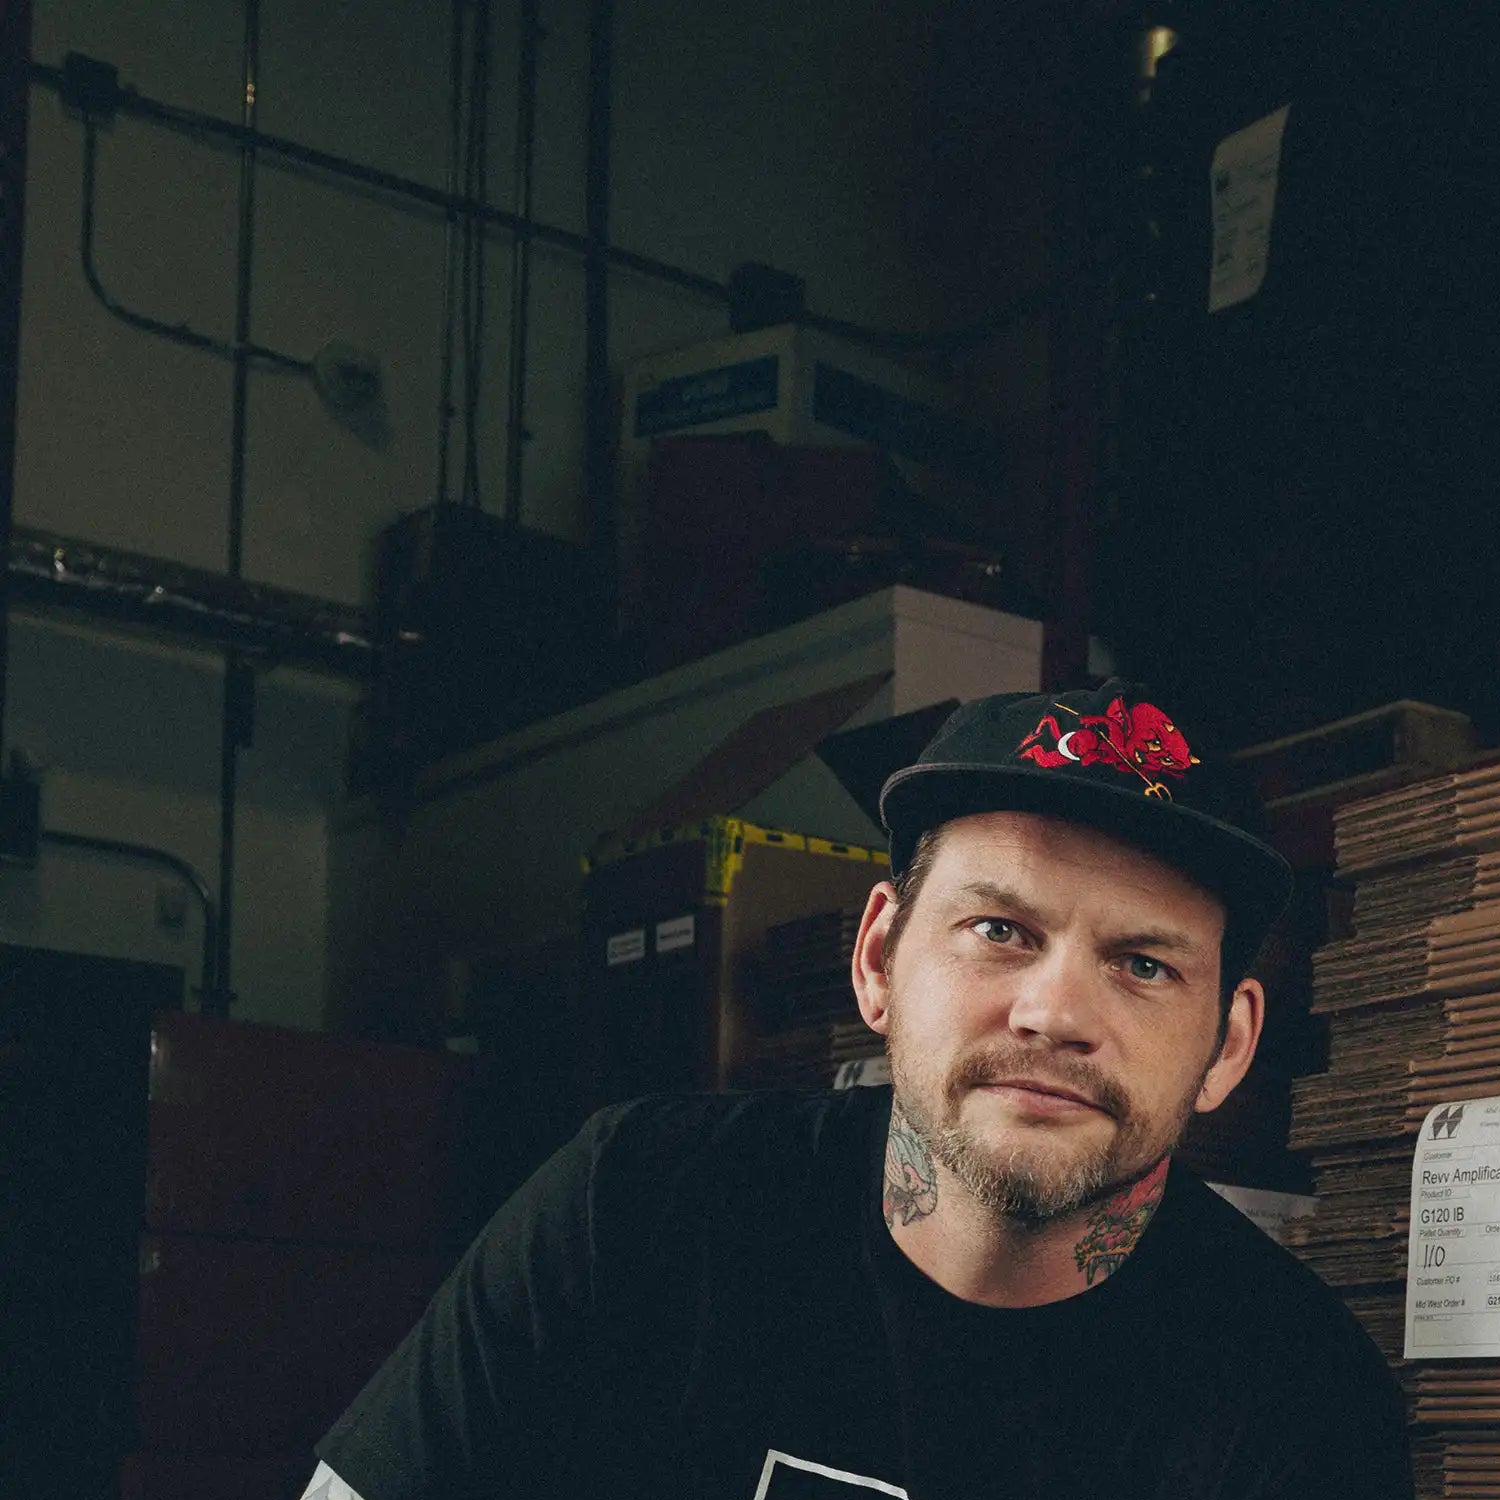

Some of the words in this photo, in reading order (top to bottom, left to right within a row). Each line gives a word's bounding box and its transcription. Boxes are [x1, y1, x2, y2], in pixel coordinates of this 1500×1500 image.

[1424, 1152, 1452, 1161] Customer
[1422, 1170, 1451, 1185] Revv
[1421, 1188, 1443, 1198] Product
[1421, 1209, 1450, 1224] G120
[1453, 1207, 1465, 1222] IB
